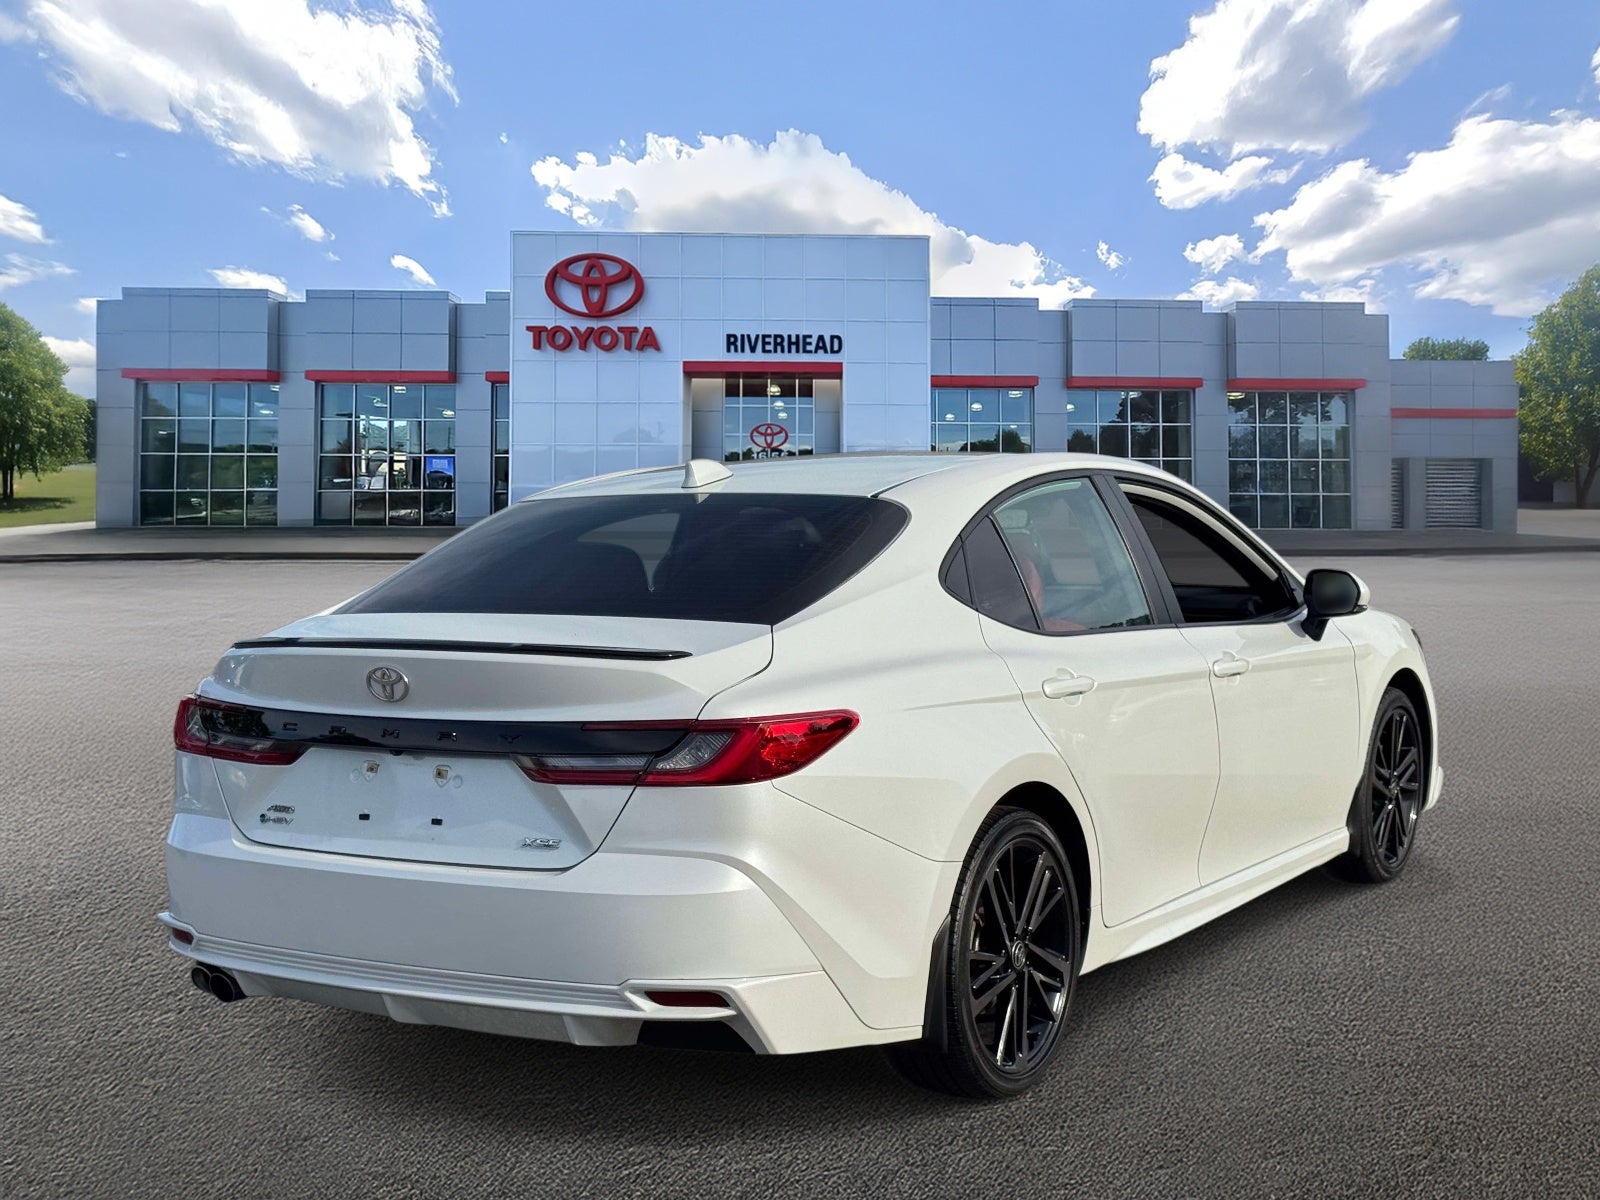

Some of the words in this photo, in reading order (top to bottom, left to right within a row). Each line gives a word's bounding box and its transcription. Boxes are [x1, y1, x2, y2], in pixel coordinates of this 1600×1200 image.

[526, 325, 661, 351] TOYOTA
[726, 333, 843, 354] RIVERHEAD
[282, 721, 522, 744] CAMRY
